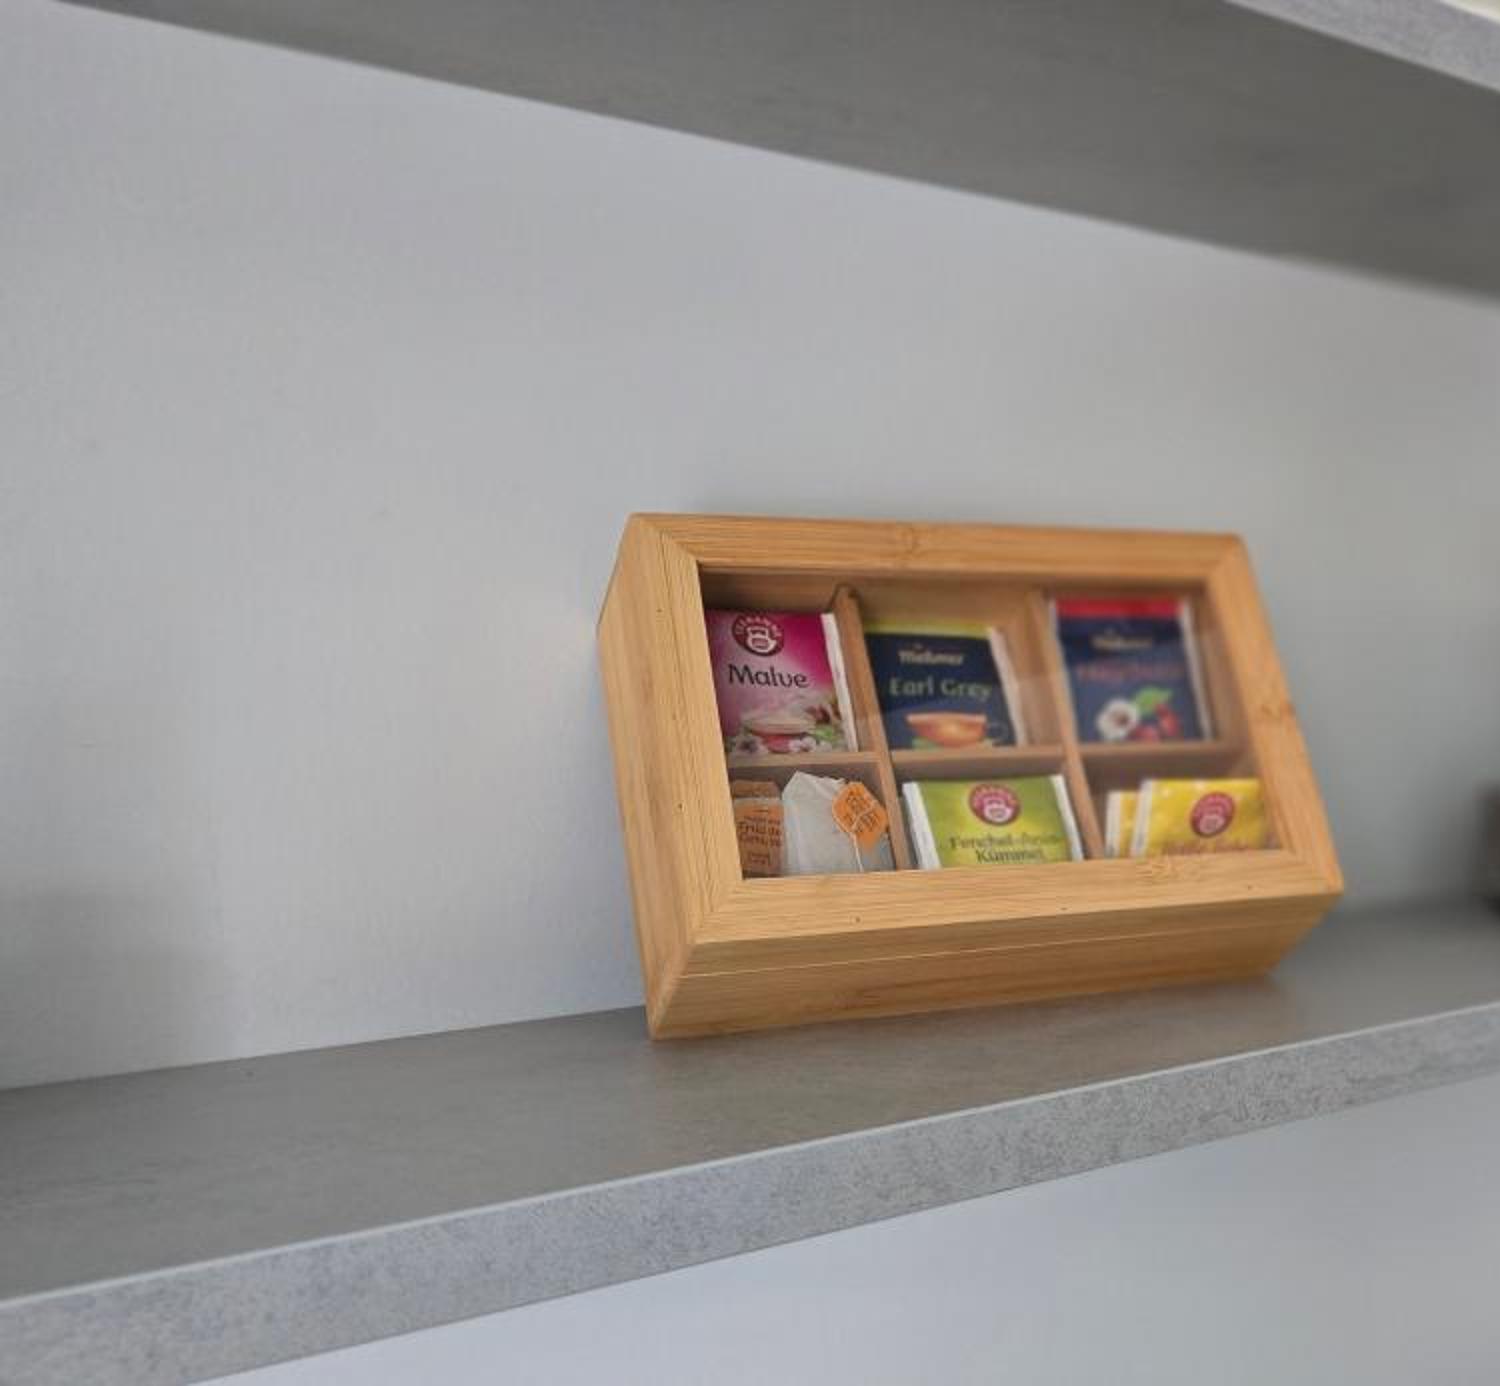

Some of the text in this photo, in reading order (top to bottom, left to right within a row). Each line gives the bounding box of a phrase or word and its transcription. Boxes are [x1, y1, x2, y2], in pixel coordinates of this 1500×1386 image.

[728, 663, 809, 689] Malve
[889, 674, 992, 703] Earl Grey
